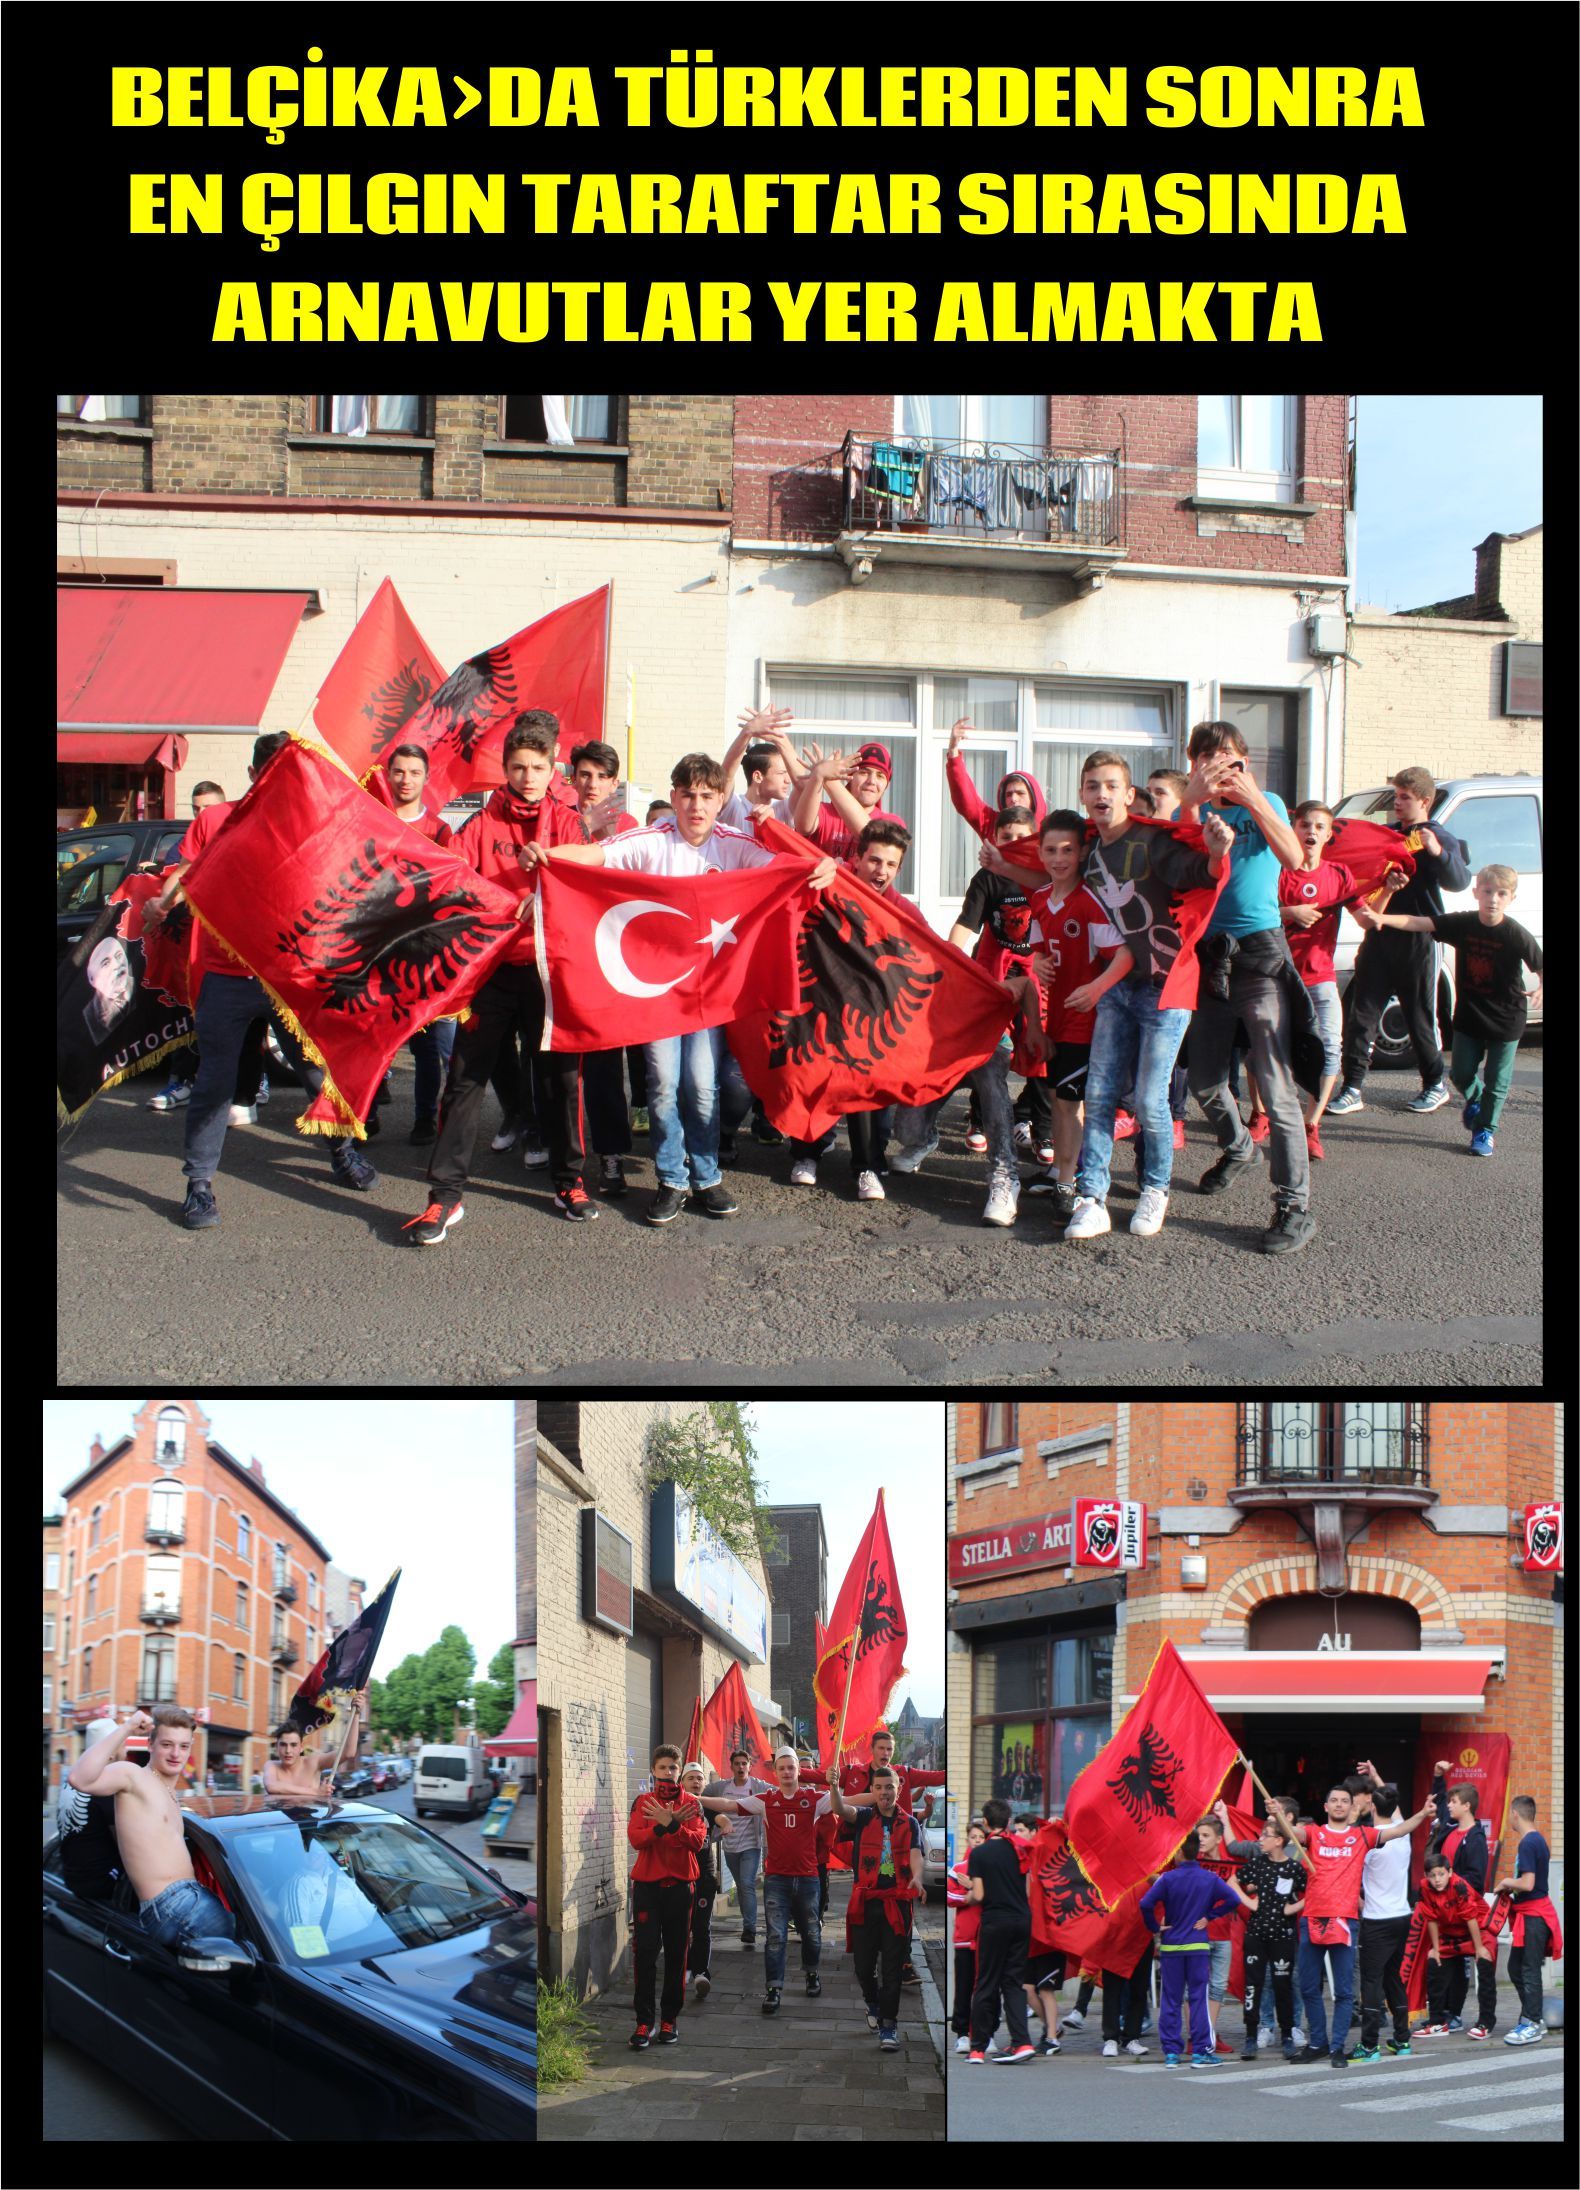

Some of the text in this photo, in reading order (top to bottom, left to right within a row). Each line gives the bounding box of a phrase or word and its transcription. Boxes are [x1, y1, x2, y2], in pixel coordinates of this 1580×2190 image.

[1049, 938, 1061, 967] 5
[102, 1016, 189, 1081] AUTOCH
[1124, 1505, 1138, 1562] Jupiler
[962, 1537, 1012, 1567] STELLA
[784, 1813, 796, 1828] 10
